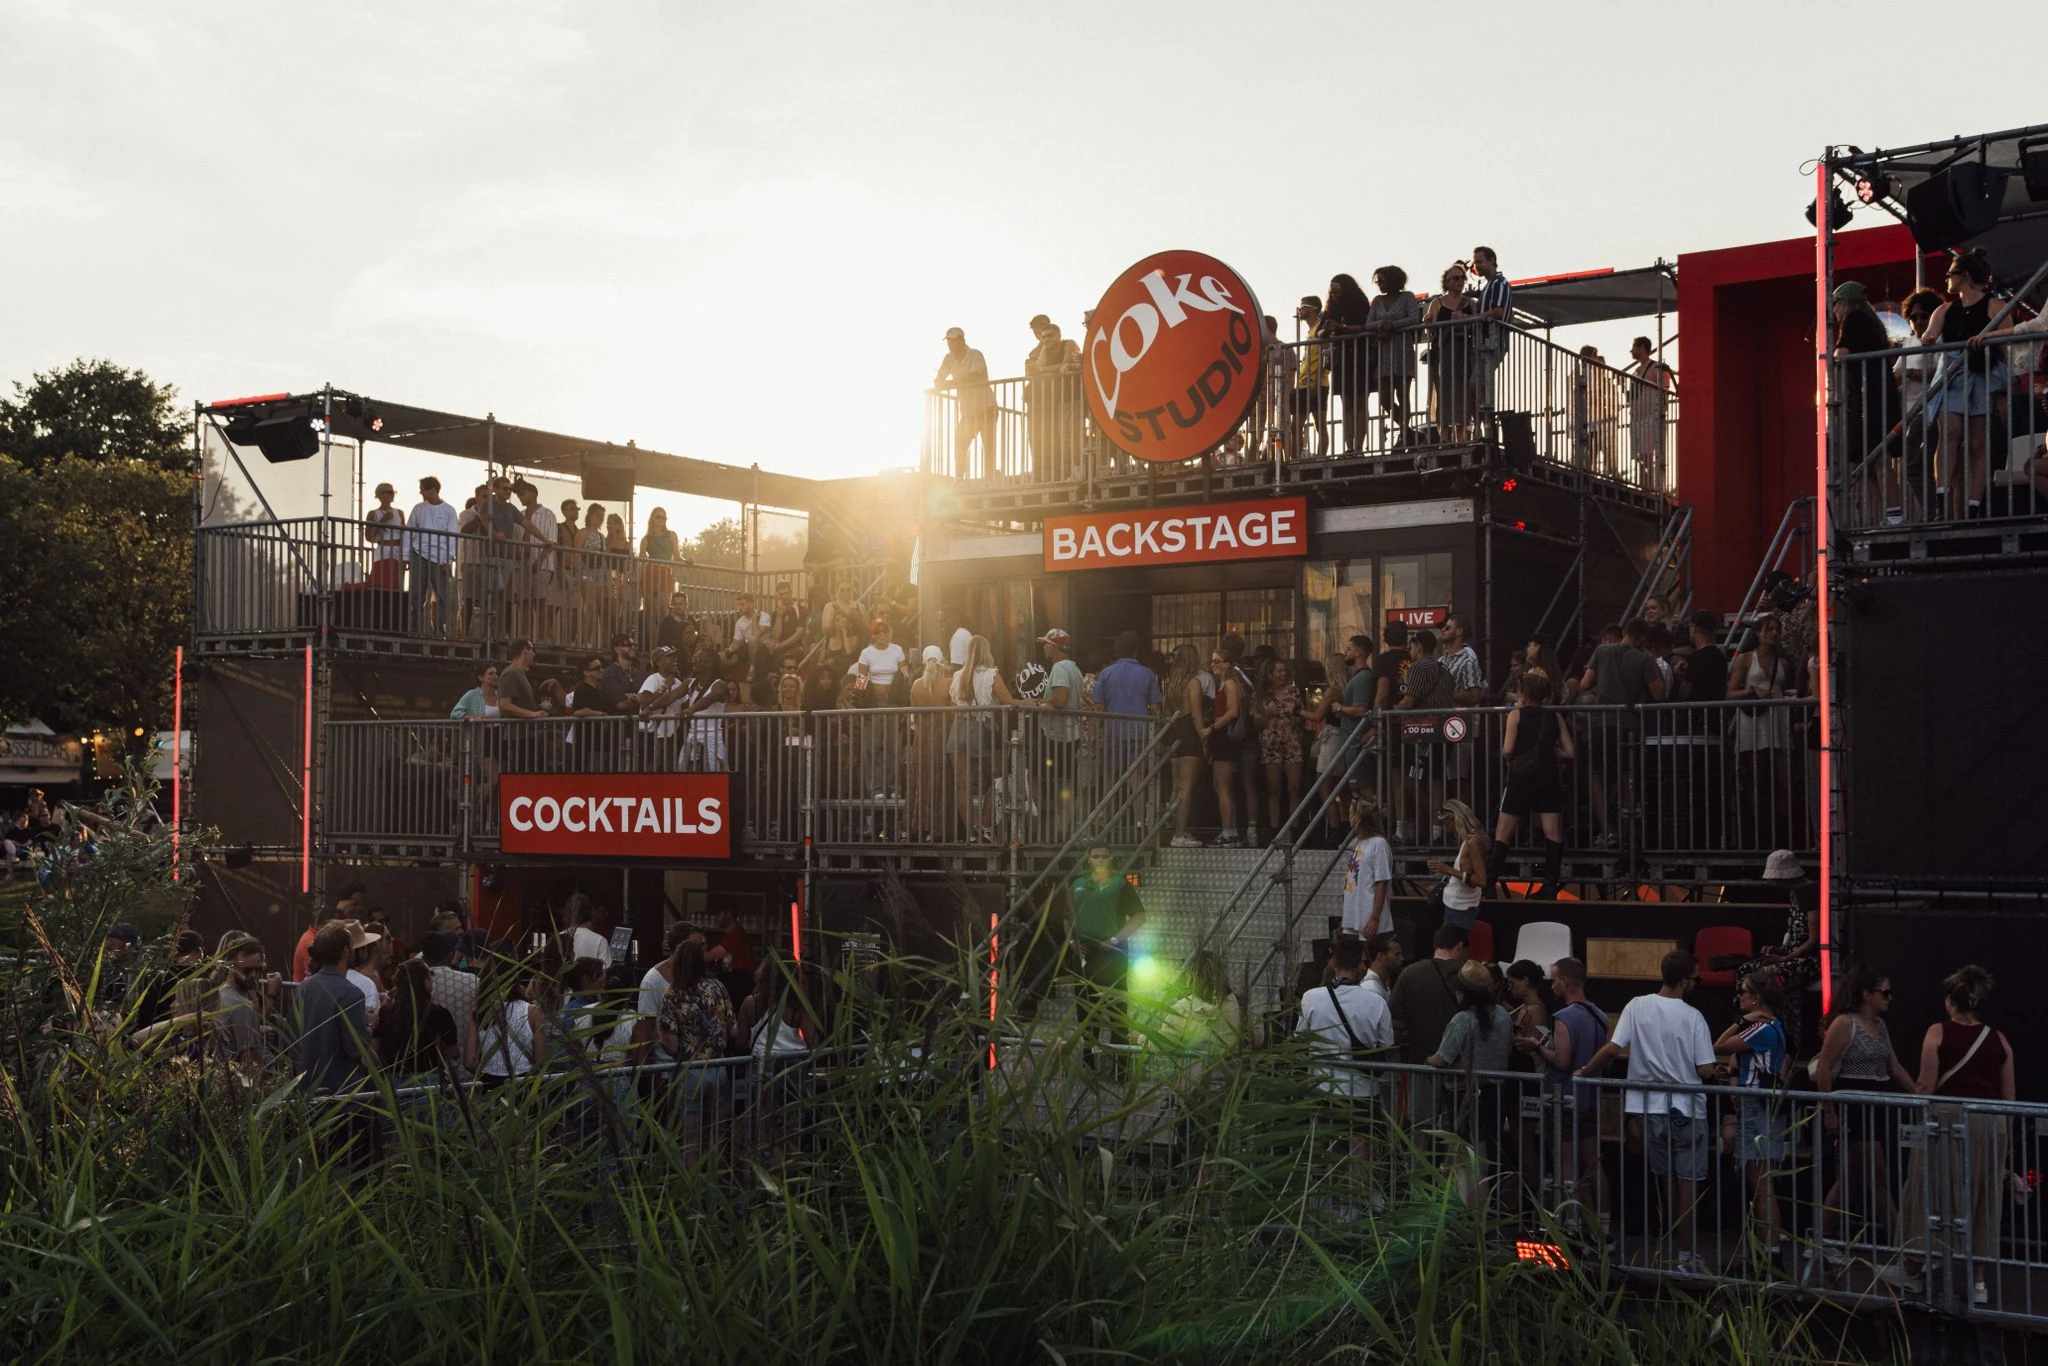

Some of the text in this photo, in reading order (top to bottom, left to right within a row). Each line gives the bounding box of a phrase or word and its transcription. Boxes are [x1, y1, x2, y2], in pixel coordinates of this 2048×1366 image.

[1091, 270, 1246, 420] Coke
[1115, 310, 1252, 443] STUDIO
[1053, 509, 1297, 561] BACKSTAGE
[1399, 611, 1434, 625] LIVE
[509, 796, 723, 835] COCKTAILS
